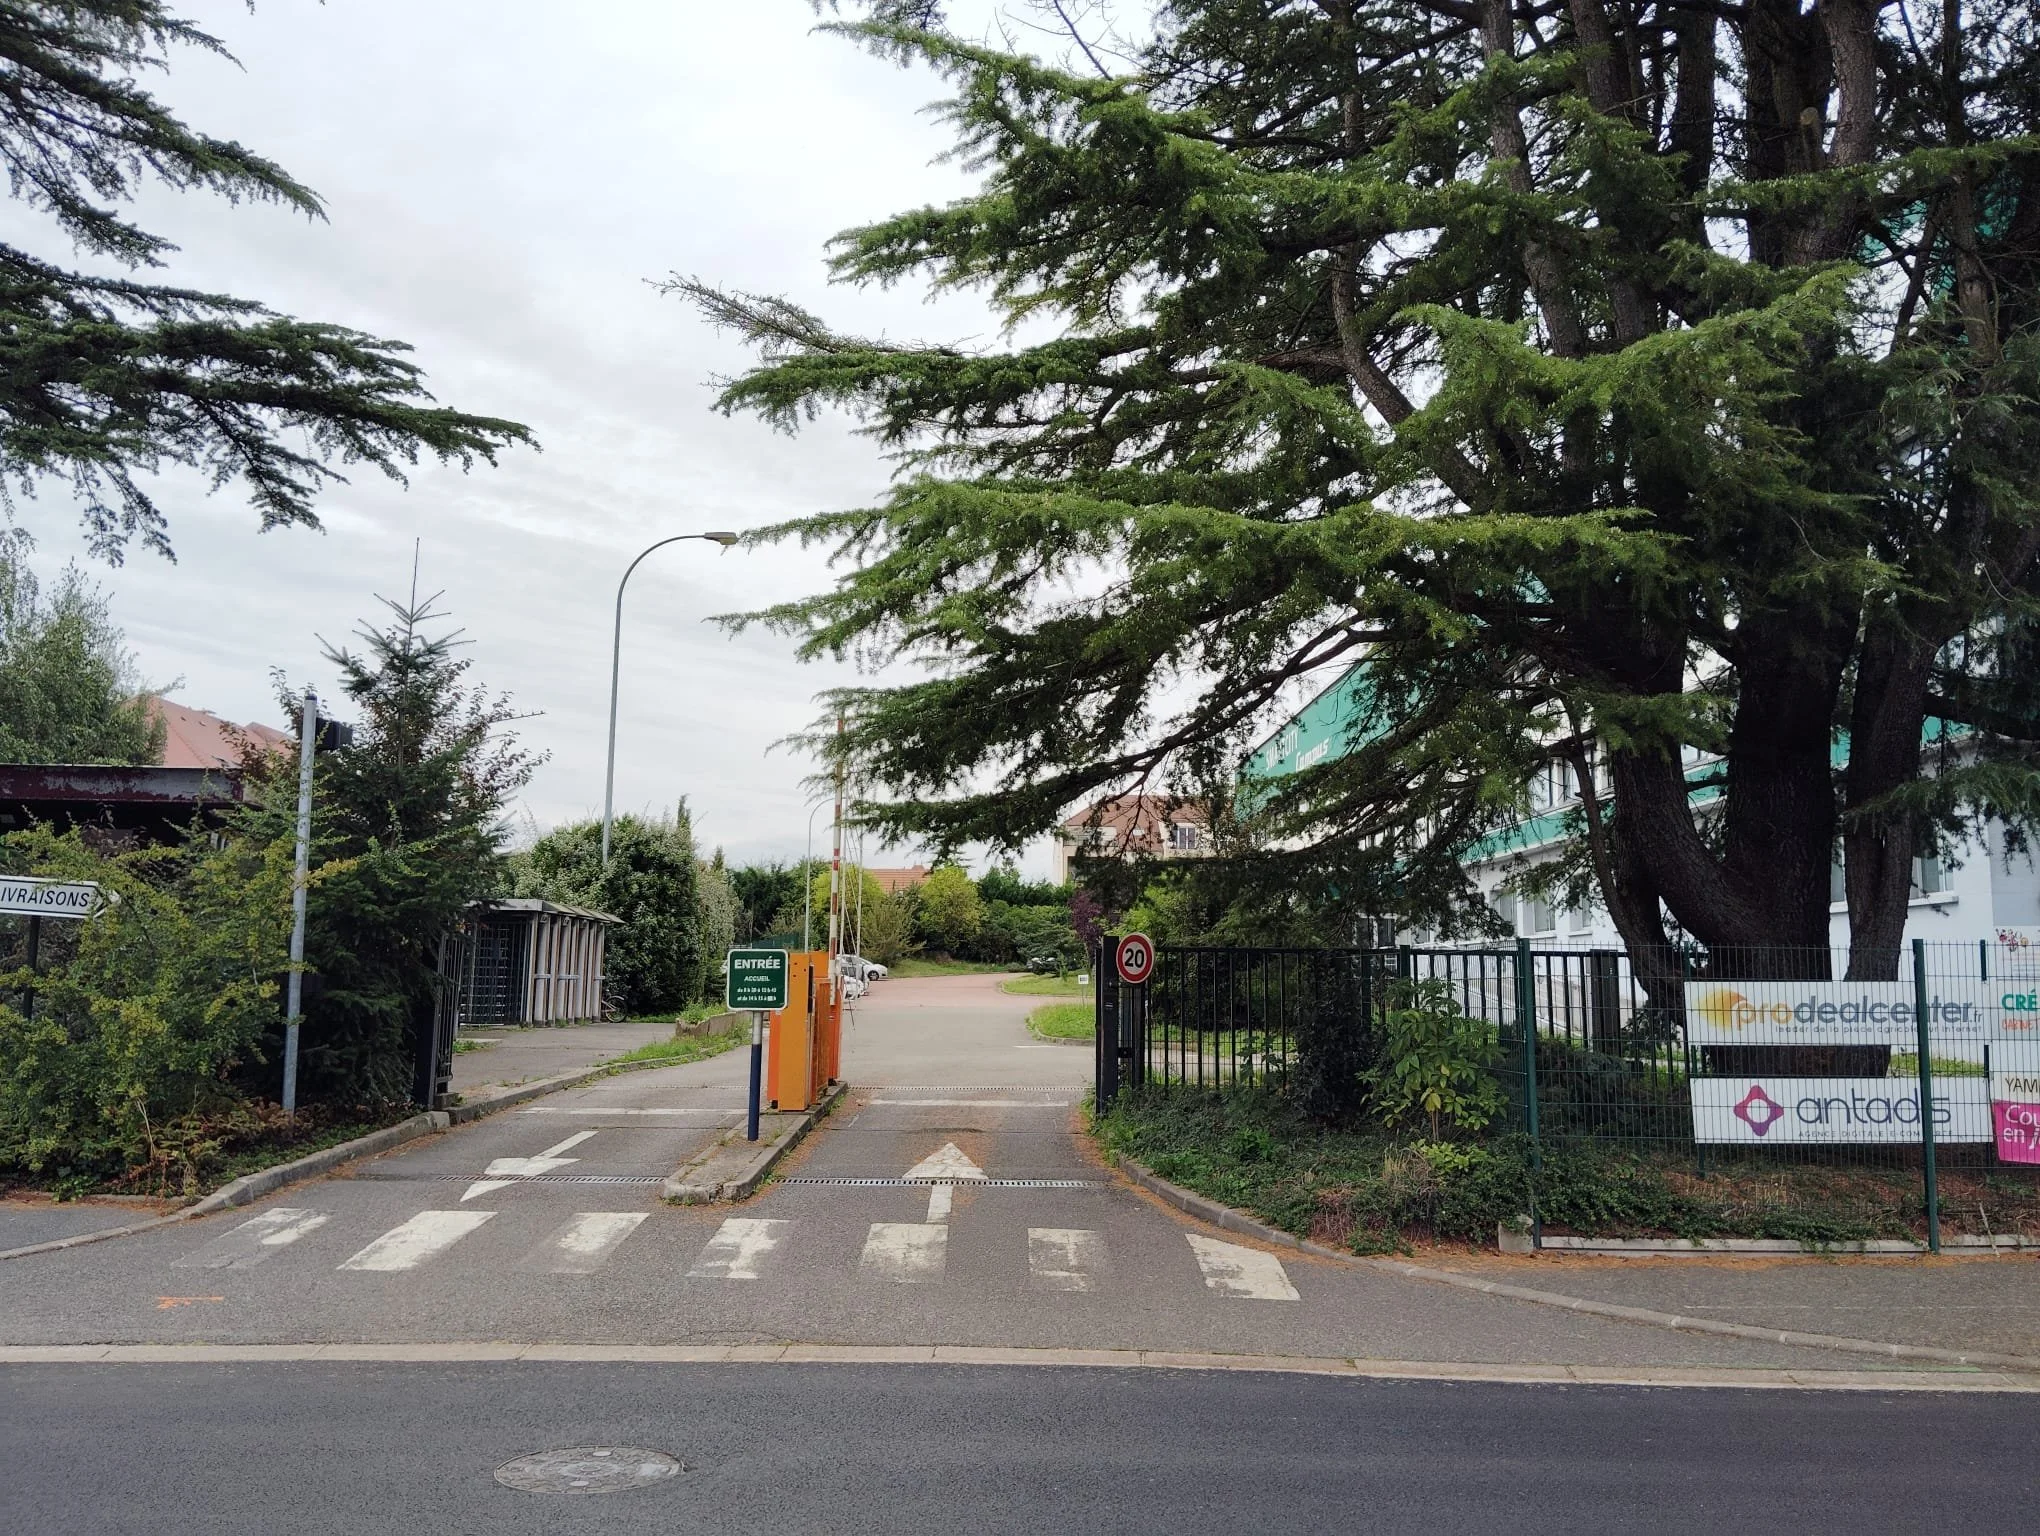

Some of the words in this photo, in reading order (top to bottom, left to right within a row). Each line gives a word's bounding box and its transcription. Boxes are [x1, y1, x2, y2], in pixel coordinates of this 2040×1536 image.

[734, 955, 781, 969] ENTRÉE
[1125, 948, 1145, 968] 20
[1796, 1088, 1951, 1124] antads
[2003, 1127, 2025, 1144] en
